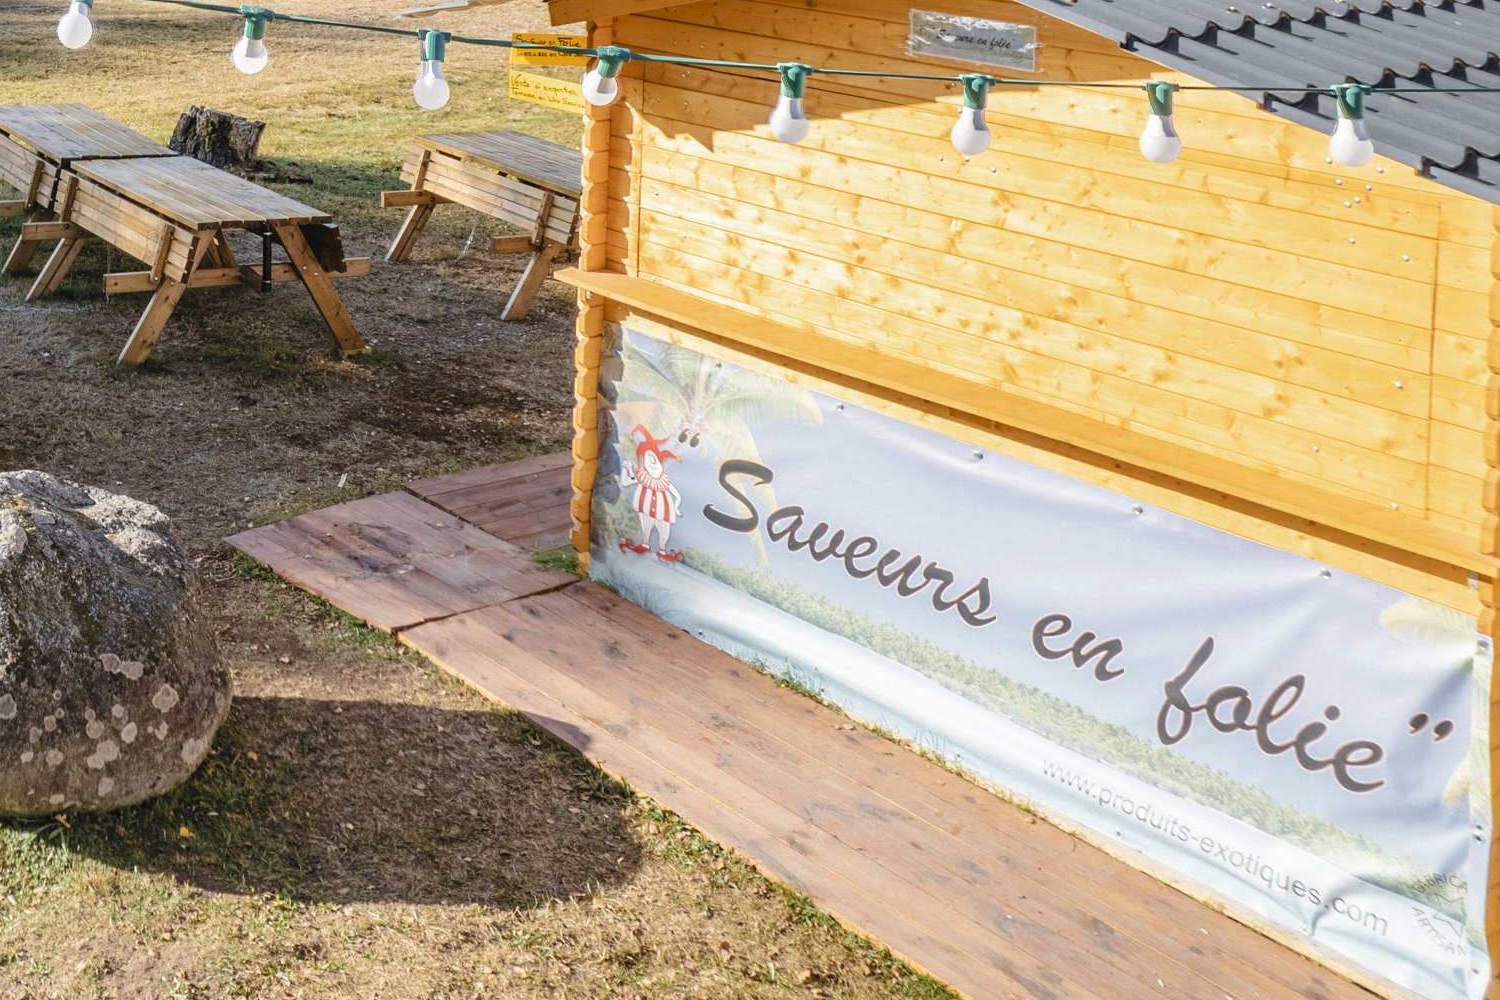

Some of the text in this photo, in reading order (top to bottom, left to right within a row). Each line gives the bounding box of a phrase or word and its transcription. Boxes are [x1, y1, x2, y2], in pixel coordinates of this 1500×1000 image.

[976, 38, 988, 46] en
[1031, 612, 1126, 682] en
[1042, 757, 1390, 936] www.produits-exotiques.com
